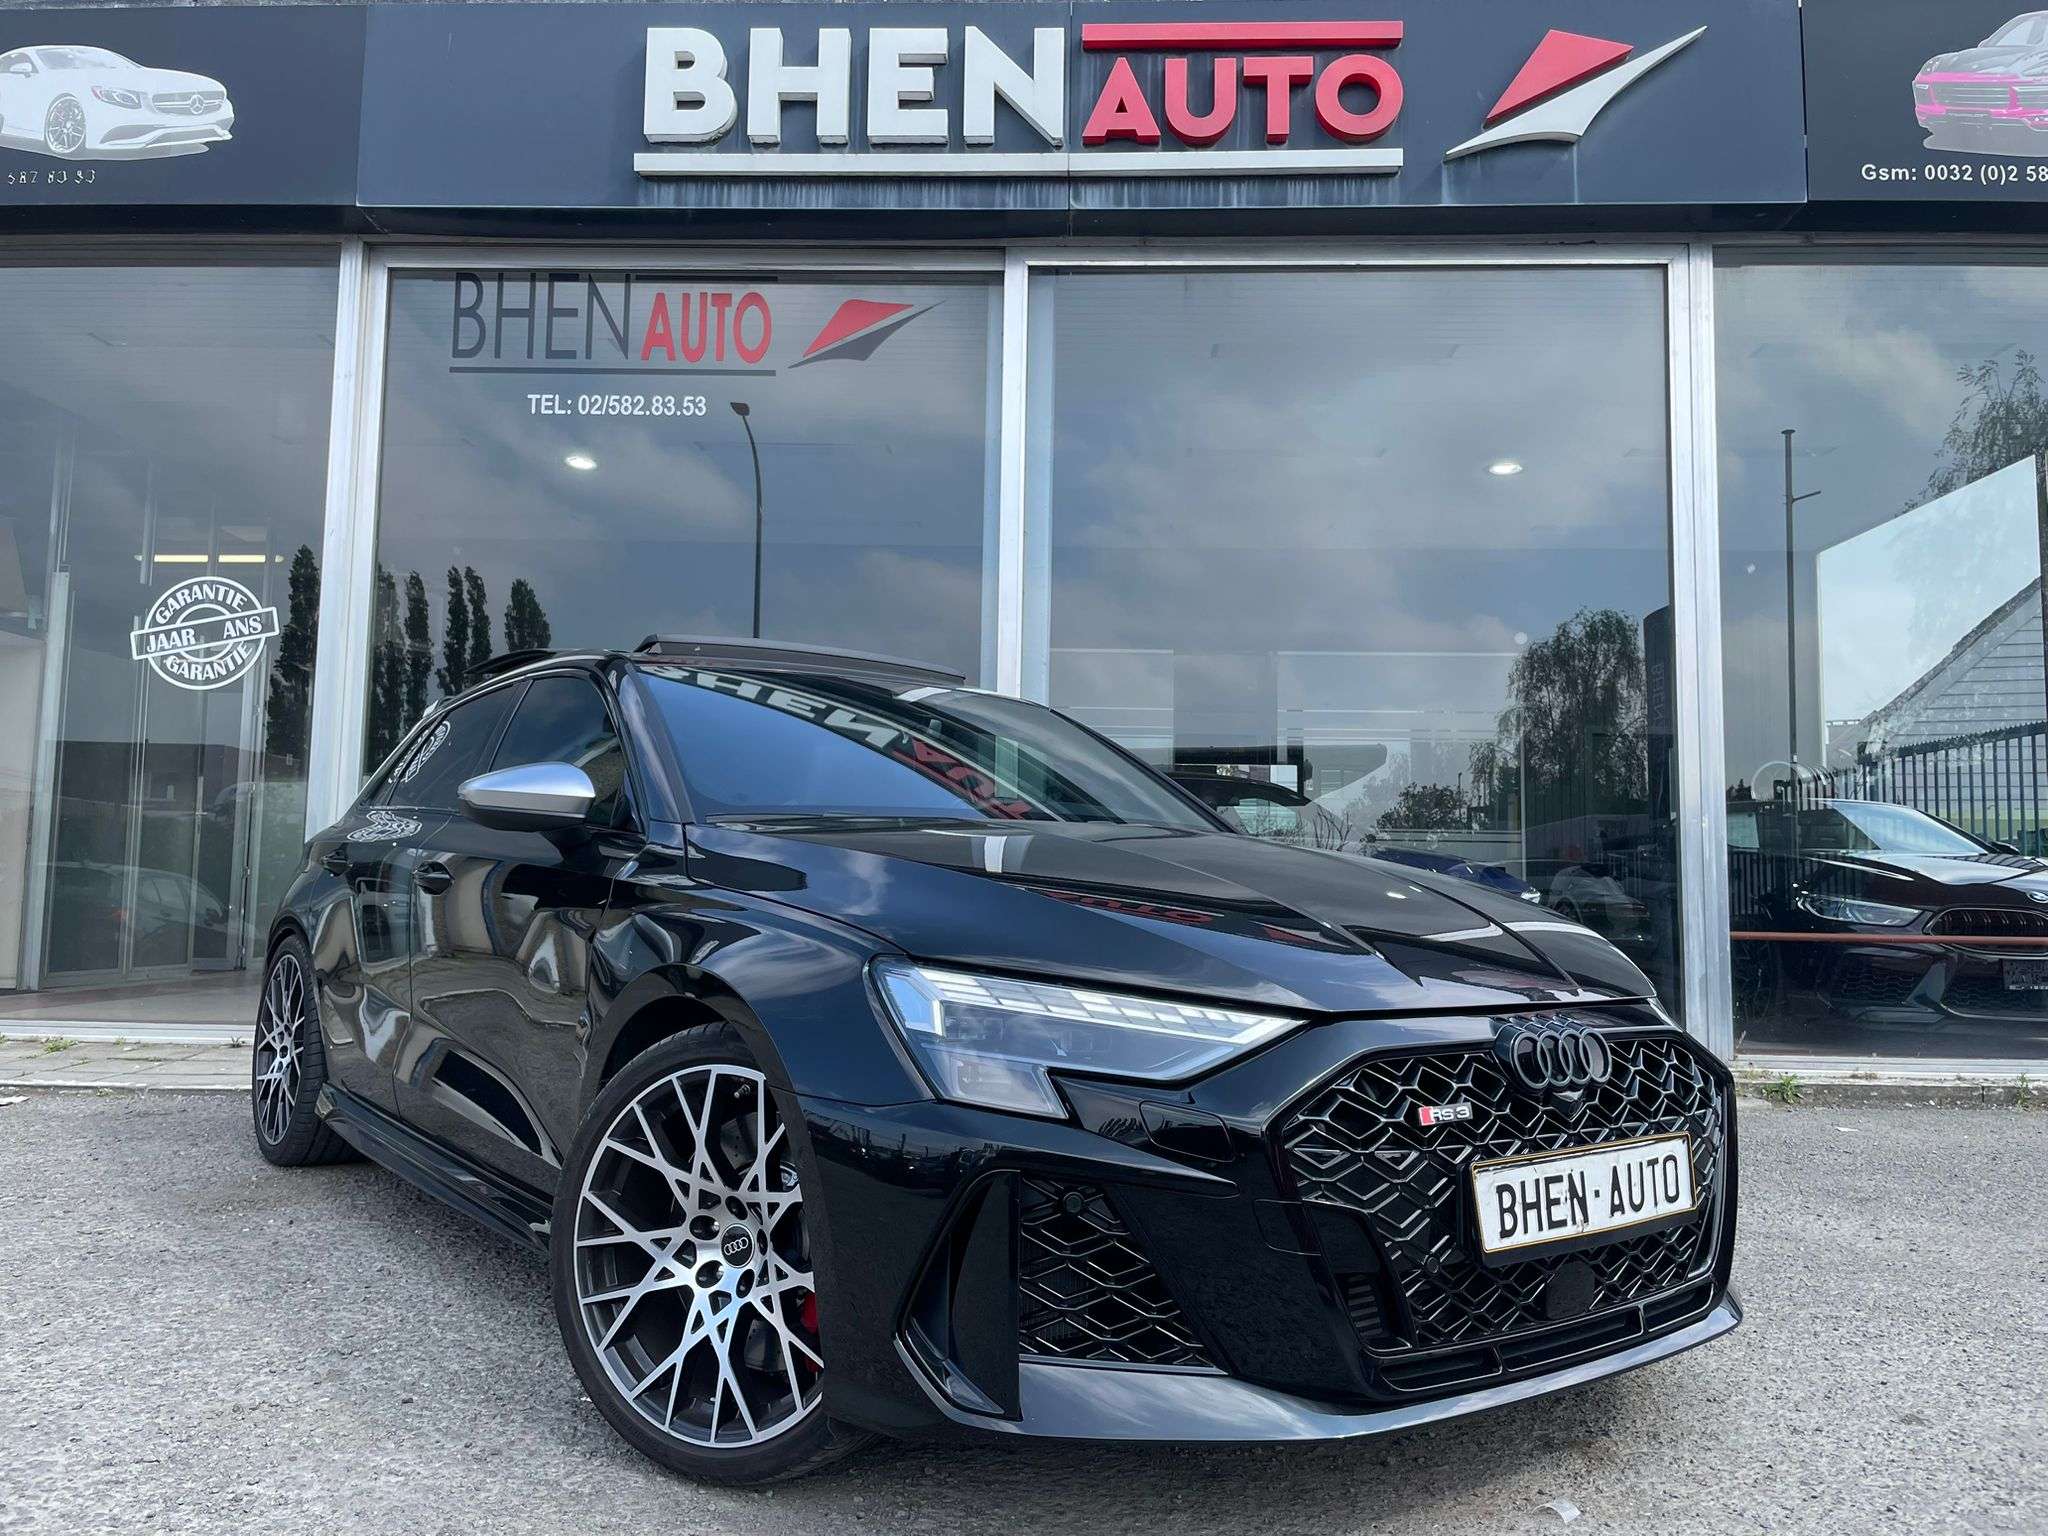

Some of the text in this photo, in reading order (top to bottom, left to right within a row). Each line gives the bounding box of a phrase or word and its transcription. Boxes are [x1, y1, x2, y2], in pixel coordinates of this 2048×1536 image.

[643, 26, 1403, 146] BHEN AUTO
[1861, 164, 1917, 181] Gsm:
[1924, 164, 1973, 182] 0032
[1980, 164, 2018, 186] (0)2
[451, 272, 773, 364] BHEN AUTO
[527, 394, 707, 416] TEL: 02/582.83.53
[155, 583, 248, 624] GARANTIE
[146, 616, 263, 653] JAAR ANS
[164, 641, 253, 681] GARANTIE
